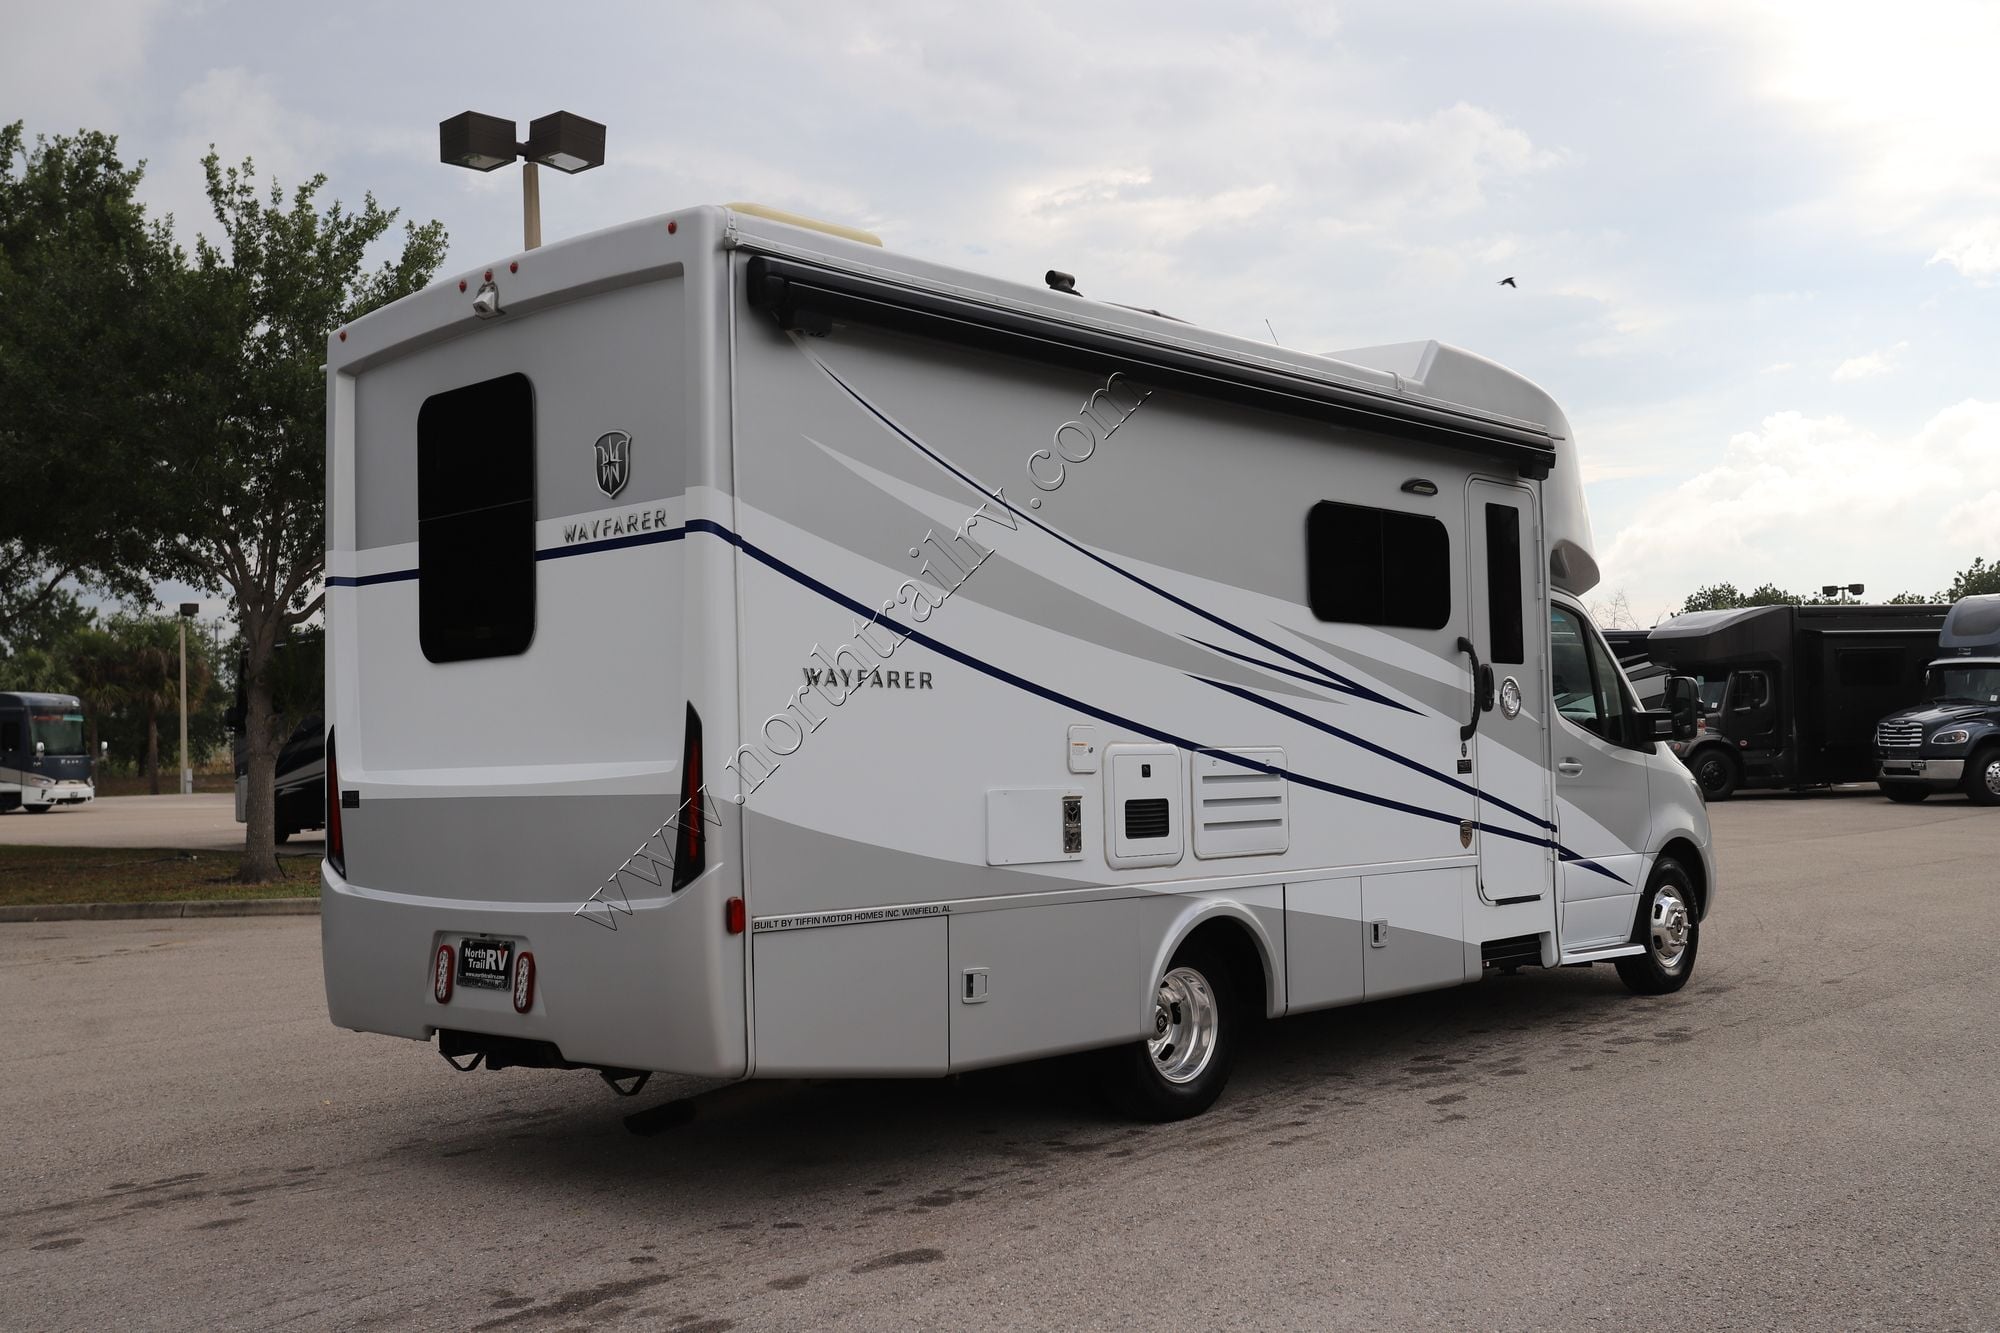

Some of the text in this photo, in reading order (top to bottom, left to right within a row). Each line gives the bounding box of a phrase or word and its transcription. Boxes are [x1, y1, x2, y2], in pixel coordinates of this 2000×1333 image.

[563, 509, 668, 543] WAYFARER
[802, 667, 934, 690] WAYFARER
[754, 920, 779, 930] BUILT
[781, 918, 793, 928] BY
[795, 916, 820, 926] TIFFIN
[822, 913, 853, 924] MOTOR
[854, 911, 884, 921] HOMES
[464, 947, 509, 971] North RV
[468, 958, 485, 969] Trail
[465, 972, 505, 980] www.northtrailrv.com
